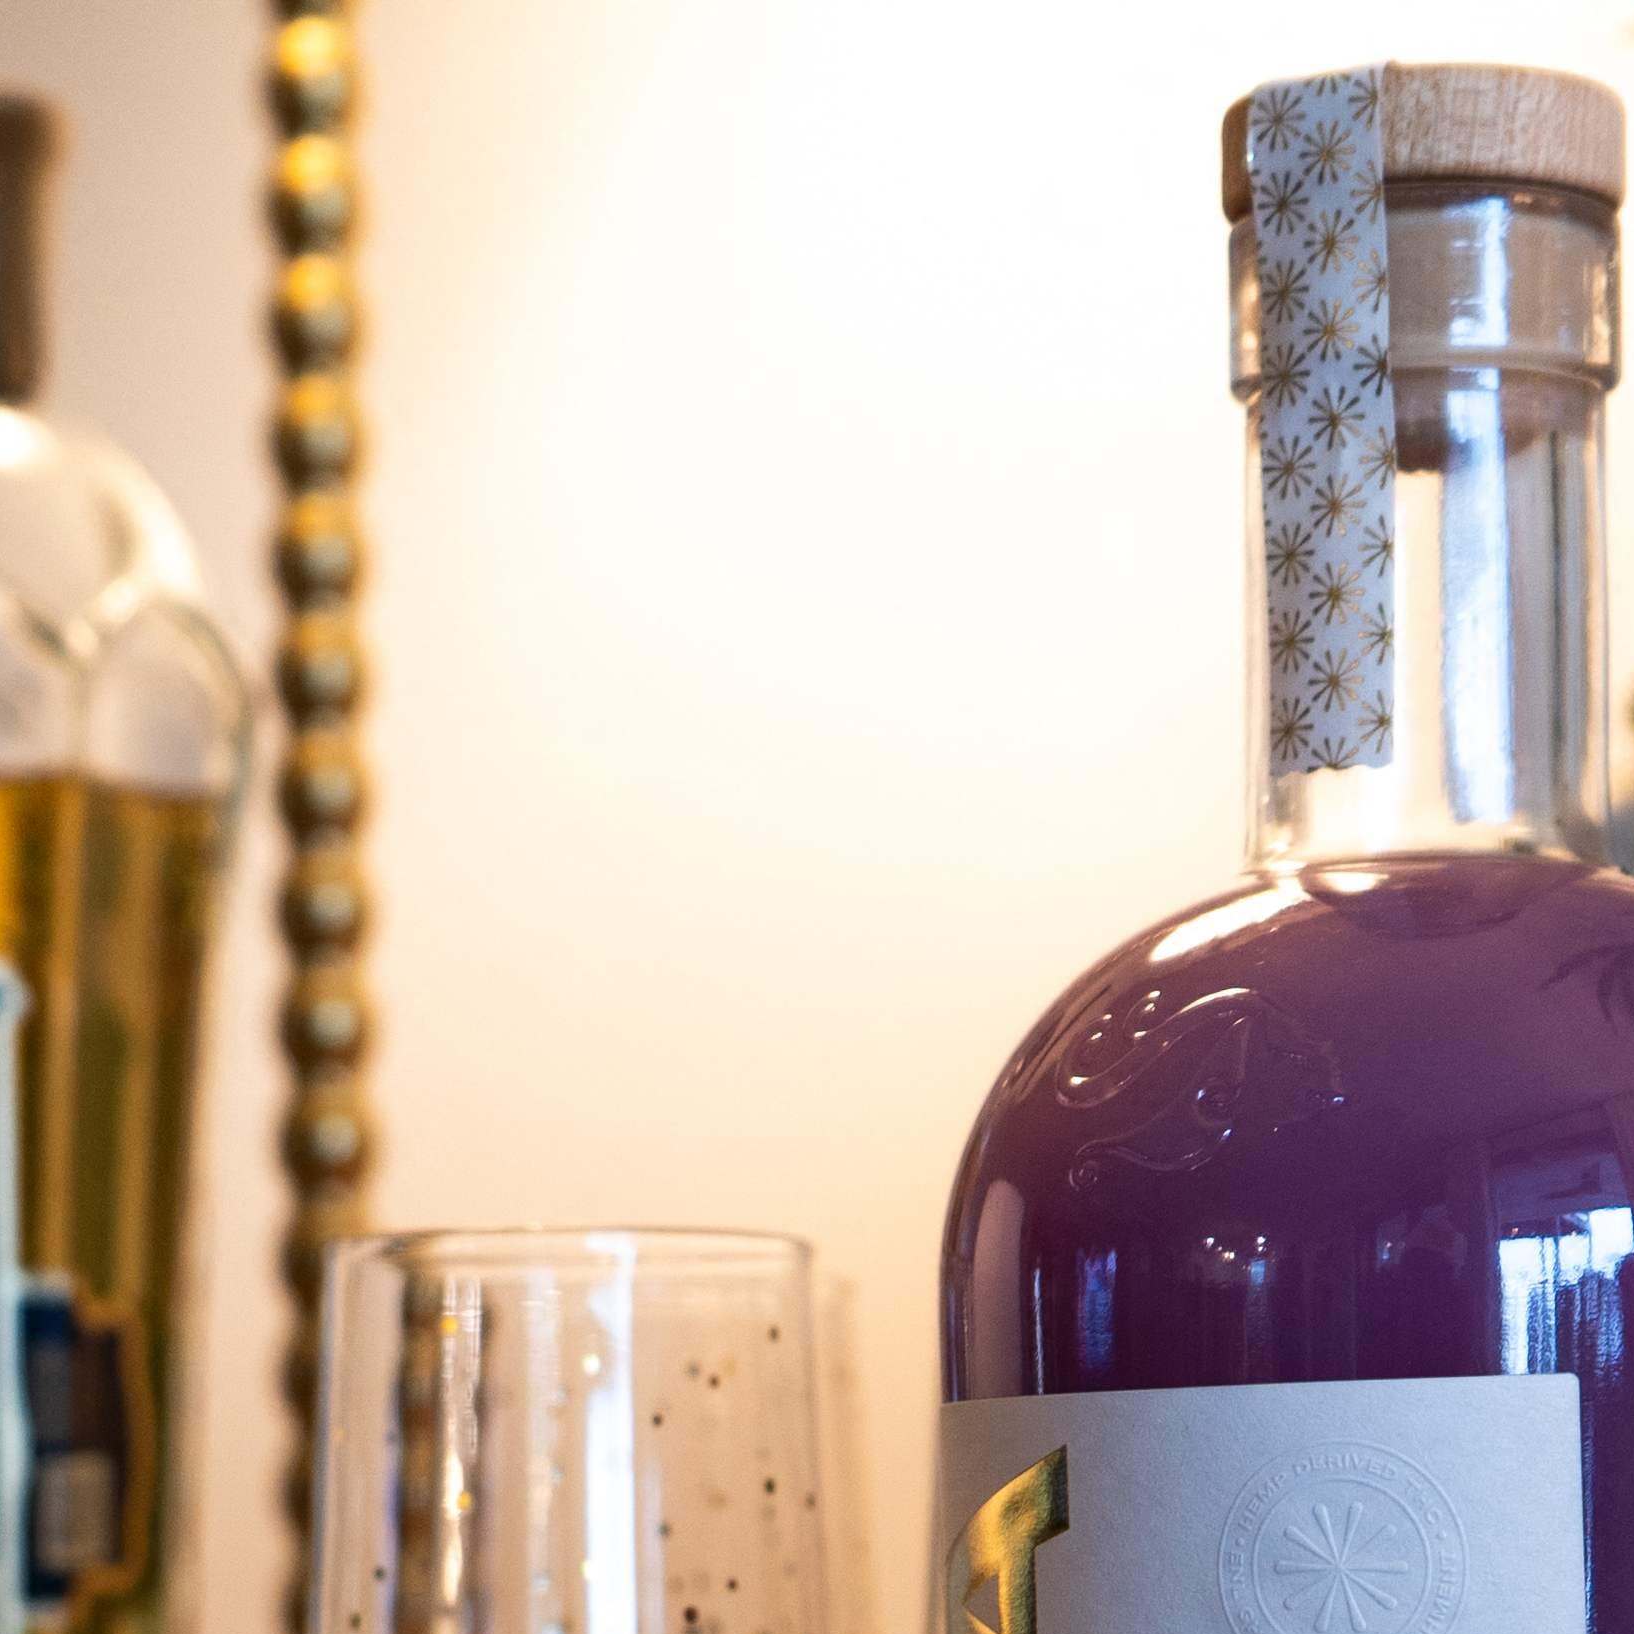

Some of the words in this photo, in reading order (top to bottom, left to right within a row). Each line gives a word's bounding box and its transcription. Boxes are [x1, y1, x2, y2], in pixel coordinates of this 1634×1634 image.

[1237, 1472, 1287, 1531] HEMP
[1292, 1453, 1397, 1479] DERIVED
[1406, 1475, 1444, 1525] THC
